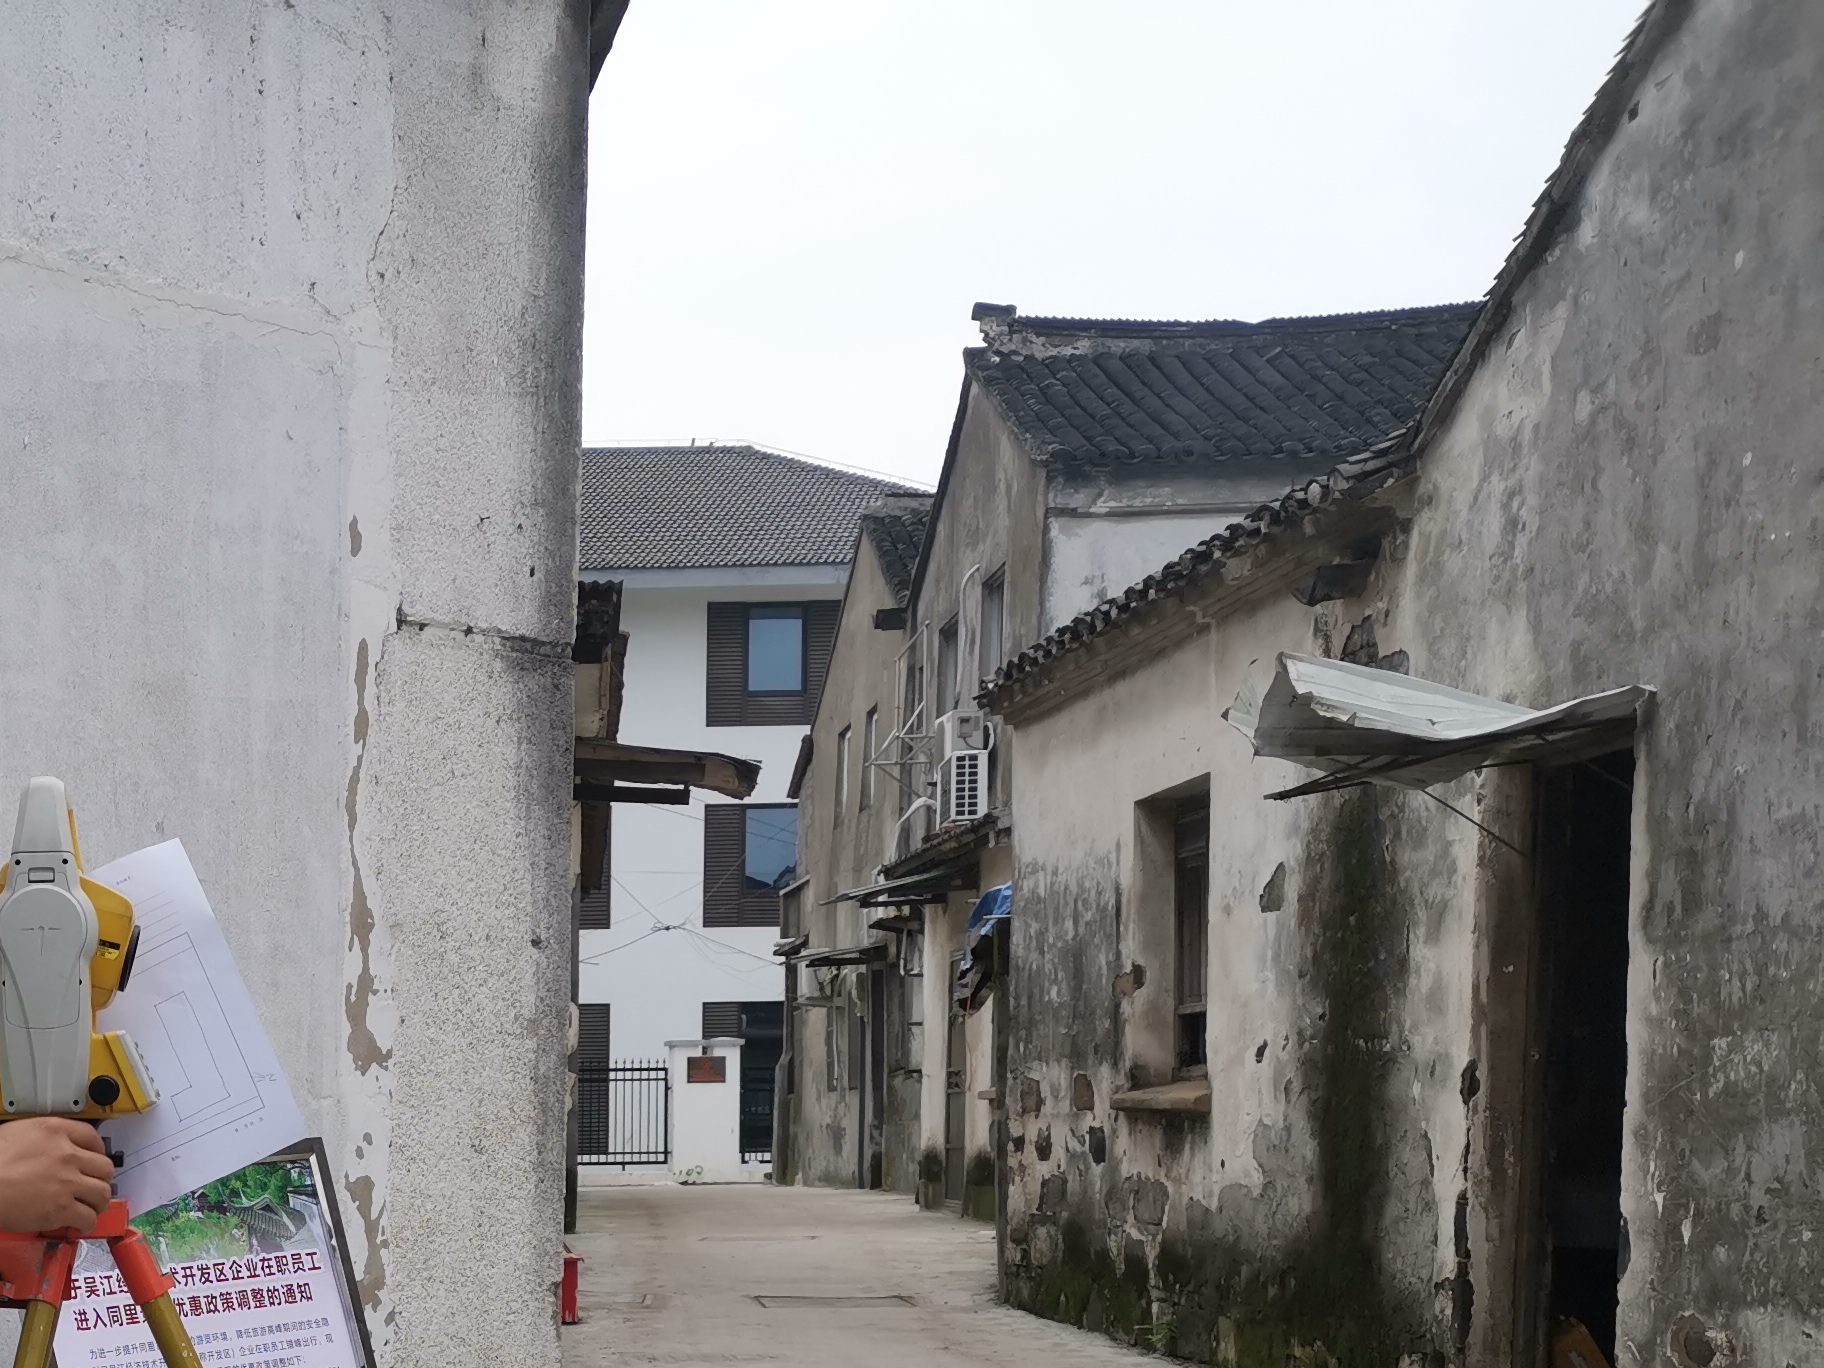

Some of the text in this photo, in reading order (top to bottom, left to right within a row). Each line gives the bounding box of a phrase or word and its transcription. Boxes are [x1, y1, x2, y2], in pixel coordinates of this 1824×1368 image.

[69, 1251, 322, 1300] 于吴江经术开发区企业在职员工
[73, 1282, 313, 1332] 进入同里优惠政策调整的通知
[88, 1316, 330, 1361] 为进一步提升同里游览环境，降低旅游高峰期间的安全隐
